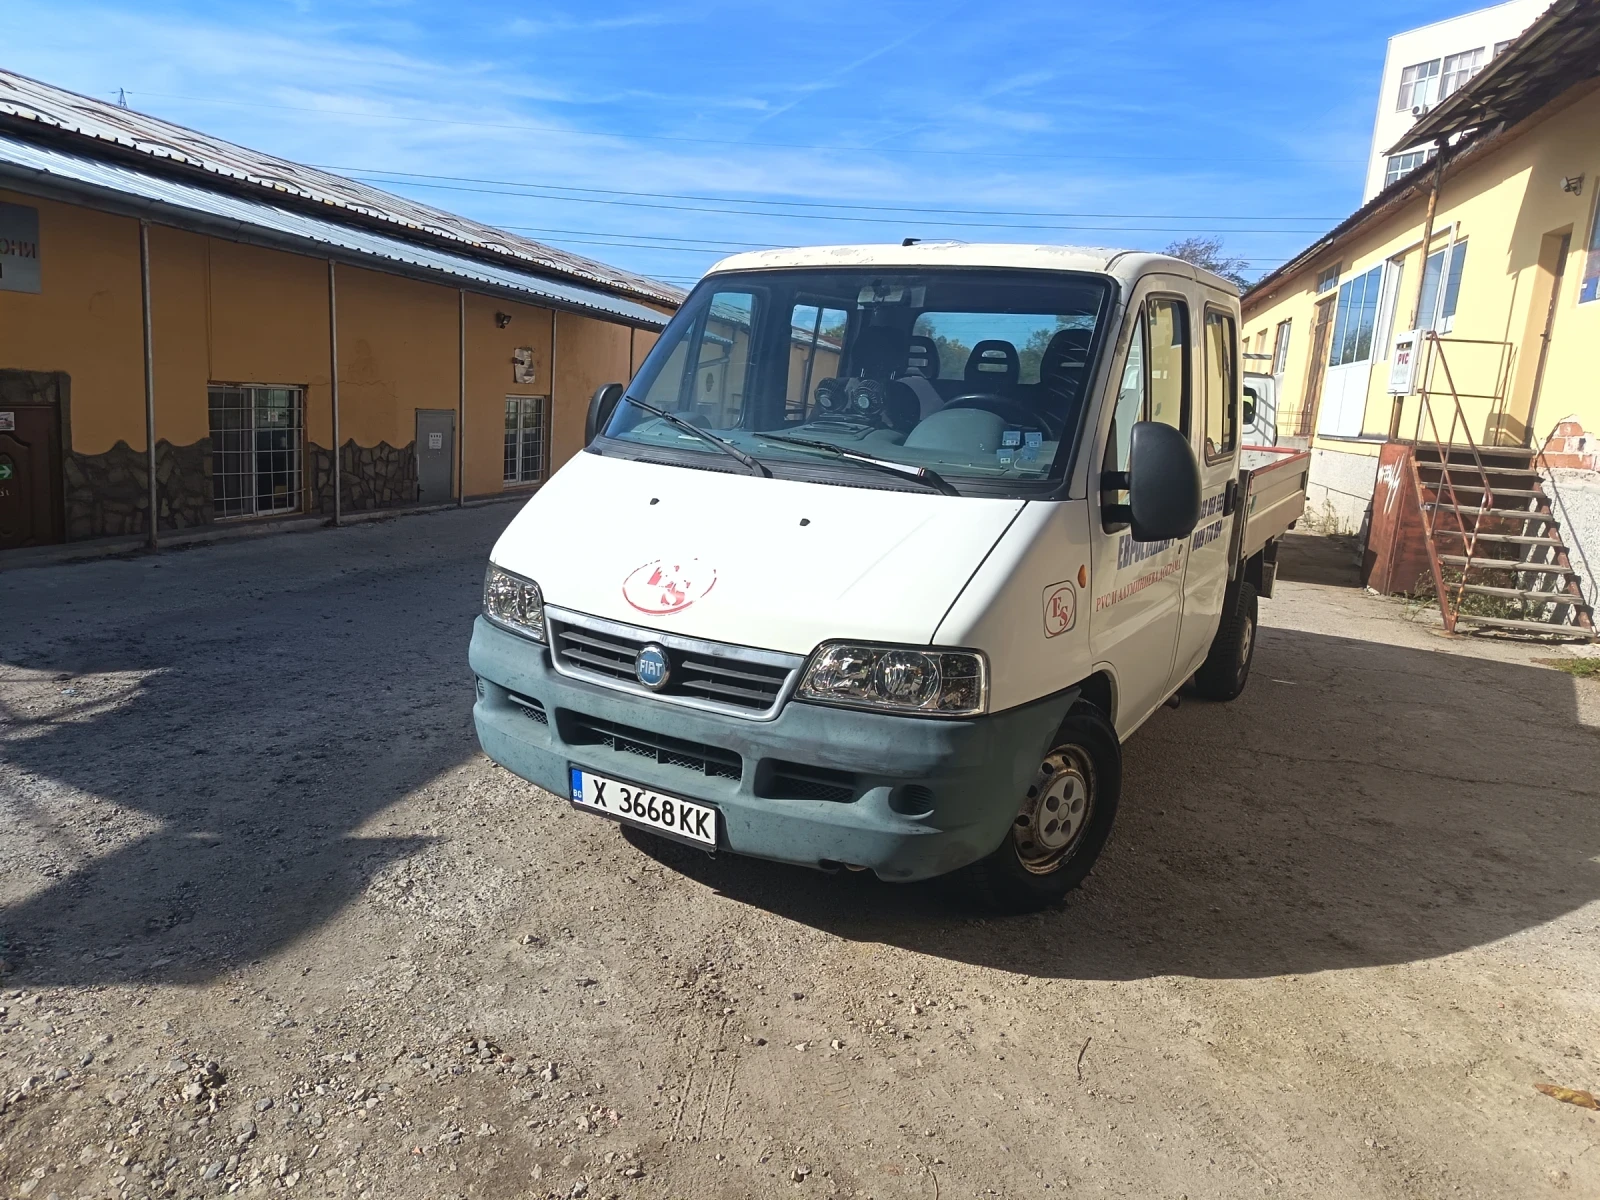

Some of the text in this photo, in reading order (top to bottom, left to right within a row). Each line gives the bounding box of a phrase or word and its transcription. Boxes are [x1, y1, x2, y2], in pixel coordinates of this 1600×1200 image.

[1096, 593, 1111, 612] PVC
[640, 659, 662, 677] FIAT
[573, 788, 582, 798] BG
